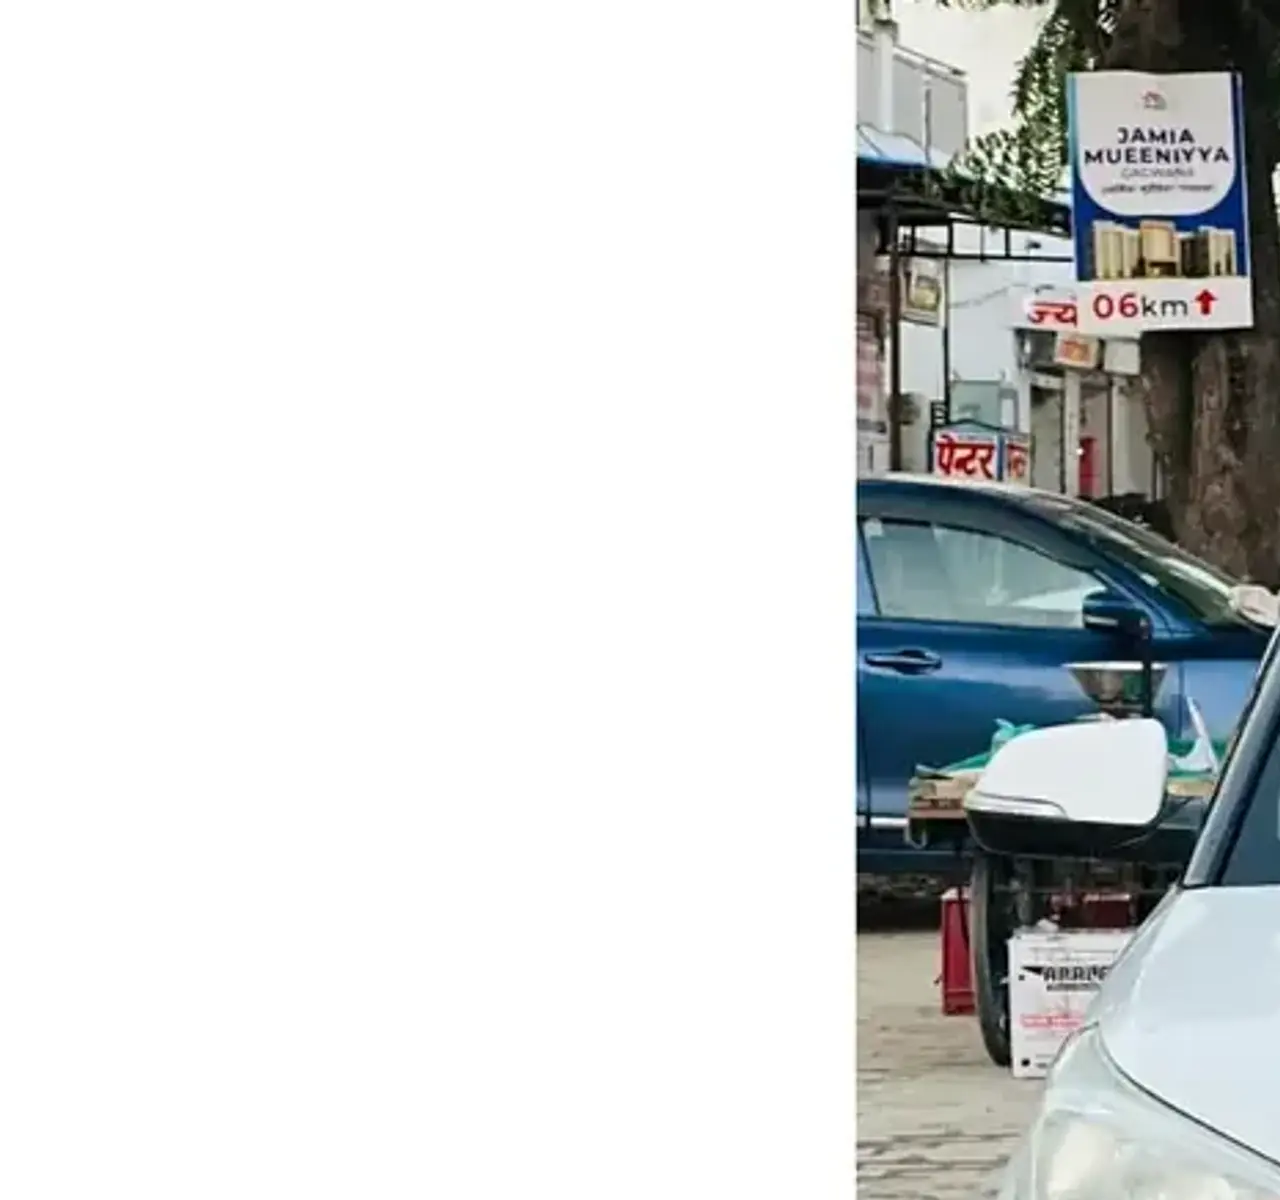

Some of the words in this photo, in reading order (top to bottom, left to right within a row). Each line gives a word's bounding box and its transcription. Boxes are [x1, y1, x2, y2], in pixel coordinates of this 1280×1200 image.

[1117, 127, 1195, 144] JAMIA
[1084, 147, 1230, 164] MUEENIYYA
[1092, 292, 1188, 319] 06km
